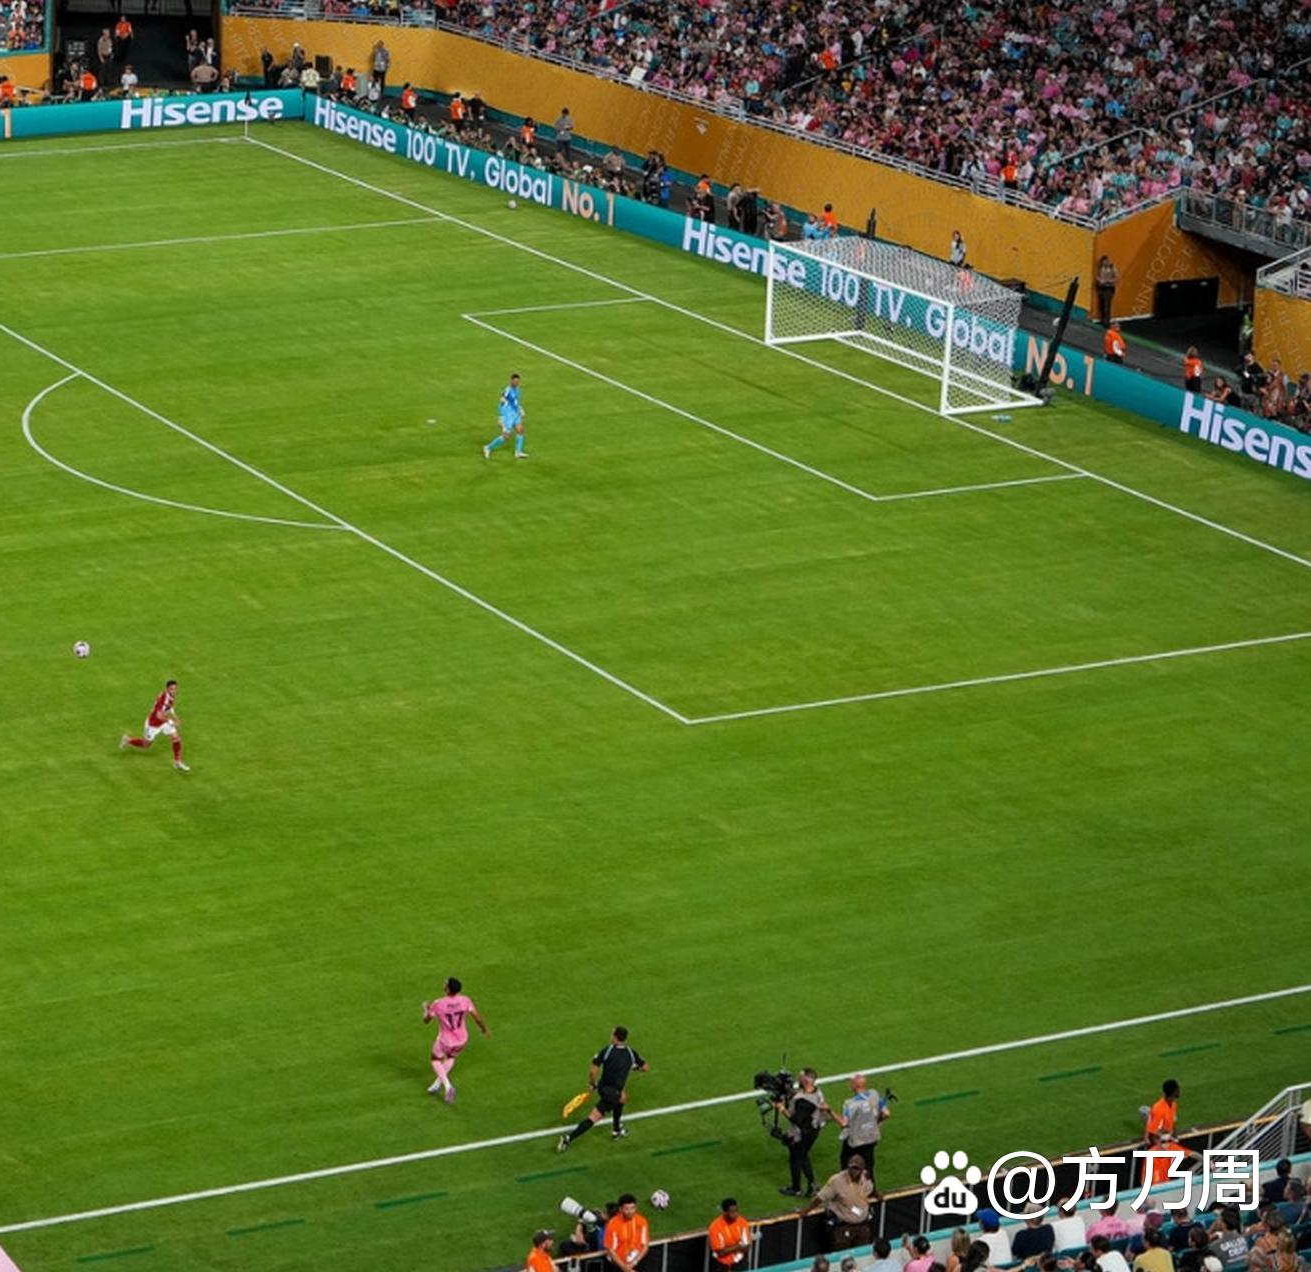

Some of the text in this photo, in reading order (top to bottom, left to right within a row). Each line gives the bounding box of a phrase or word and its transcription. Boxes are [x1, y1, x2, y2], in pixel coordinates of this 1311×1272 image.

[0, 108, 12, 138] 1
[121, 97, 283, 128] Hisense
[314, 96, 396, 153] Hisense
[445, 142, 476, 180] TV,
[485, 156, 553, 206] Global
[561, 179, 600, 221] No.
[605, 192, 616, 227] 1
[682, 217, 806, 288] Hisense
[925, 304, 1015, 368] Gobal
[1026, 337, 1074, 390] No.
[1084, 355, 1095, 396] 1
[445, 1011, 465, 1031] 17
